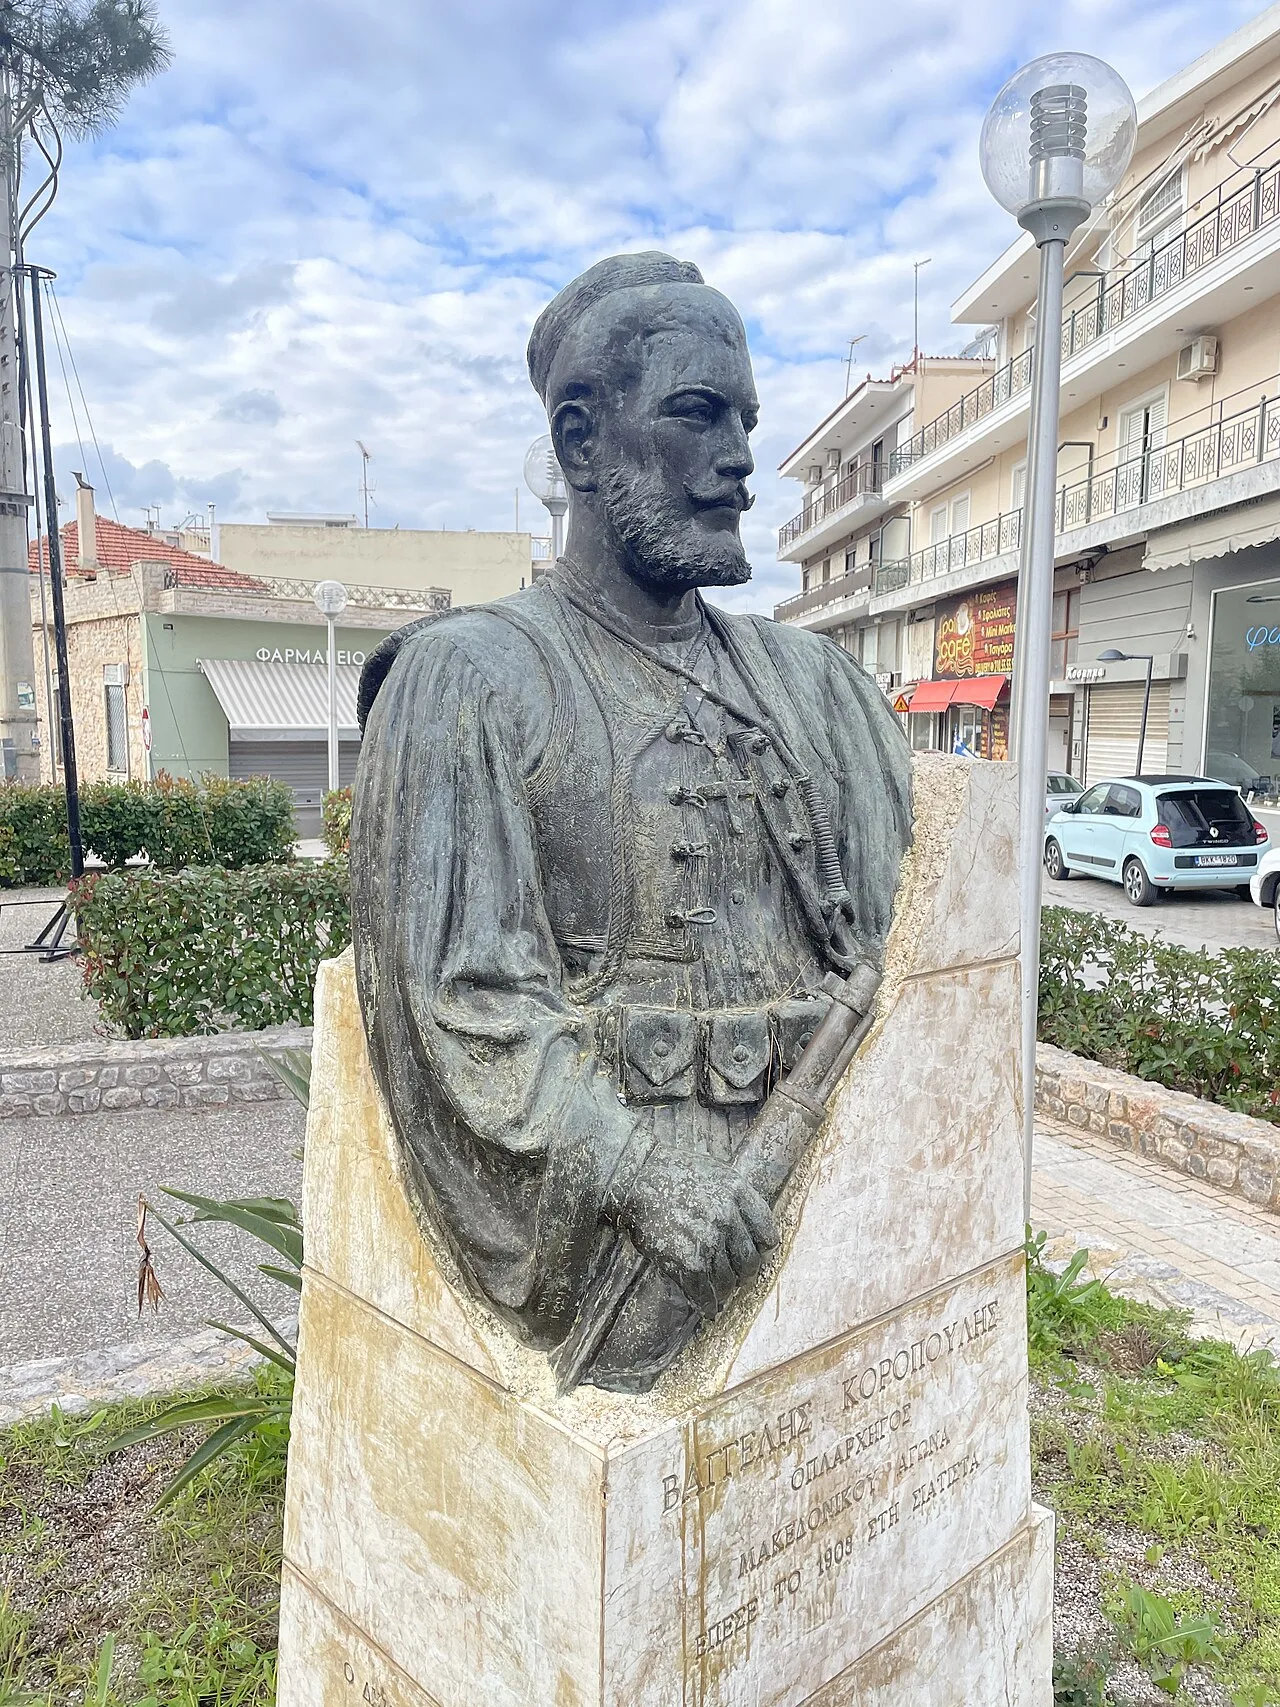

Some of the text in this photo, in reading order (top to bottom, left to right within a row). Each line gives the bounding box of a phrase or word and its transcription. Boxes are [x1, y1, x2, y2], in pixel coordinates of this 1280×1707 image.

[986, 622, 1016, 638] Mini Marke
[662, 1300, 999, 1516] ΒΑΓΓΕΛΗΣ ΚΟΡΟΠΟΥΛΗΣ
[791, 1403, 911, 1491] ΟΠΛΑΡΧΗΓΟΣ
[694, 1451, 980, 1659] ΕΠΕΣΕ ΤΟ 1908 ΣΤΗ ΣΙΑΤΙΣΤΑ
[738, 1426, 951, 1579] ΜΑΚΕΔΟΝΙΚΟΥ ΑΓΩΝΑ
